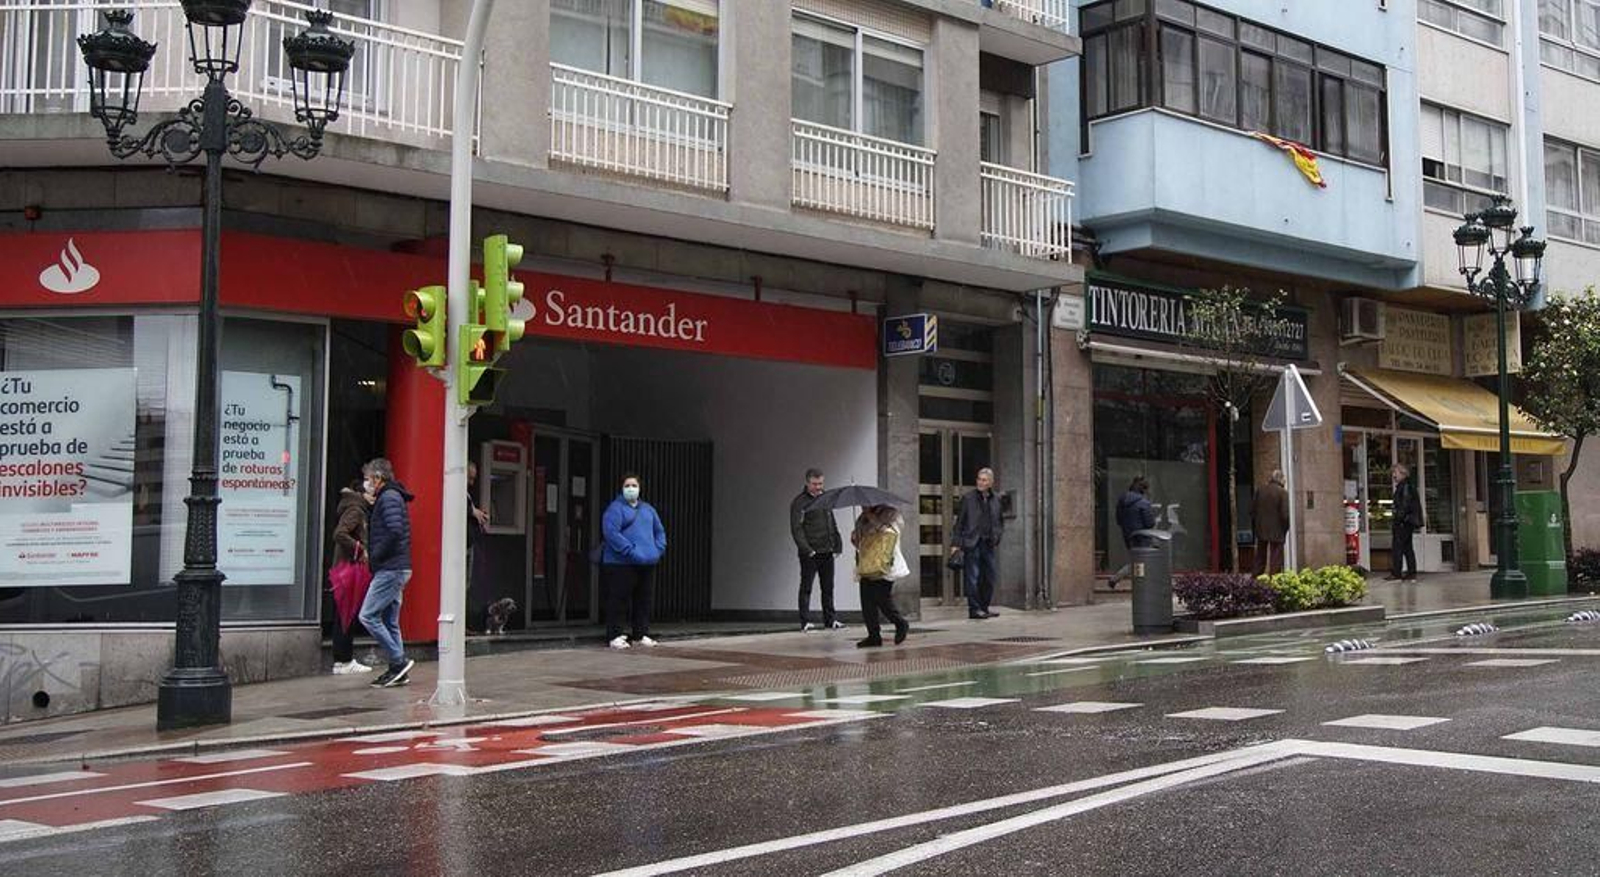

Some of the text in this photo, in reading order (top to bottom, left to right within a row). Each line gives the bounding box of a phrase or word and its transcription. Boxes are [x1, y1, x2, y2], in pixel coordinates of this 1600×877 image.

[545, 290, 708, 342] Santander
[1088, 285, 1187, 337] TINTORERIA
[1, 378, 31, 394] ¿Tu
[0, 396, 80, 414] comercio
[224, 404, 246, 416] ¿Tu
[0, 417, 52, 435] está a
[224, 420, 271, 433] negocio
[223, 433, 259, 445] está a
[0, 438, 88, 460] prueba de
[223, 449, 265, 461] prueba
[0, 460, 84, 477] escalones
[222, 462, 283, 475] de roturas
[221, 478, 296, 491] espontáneas?
